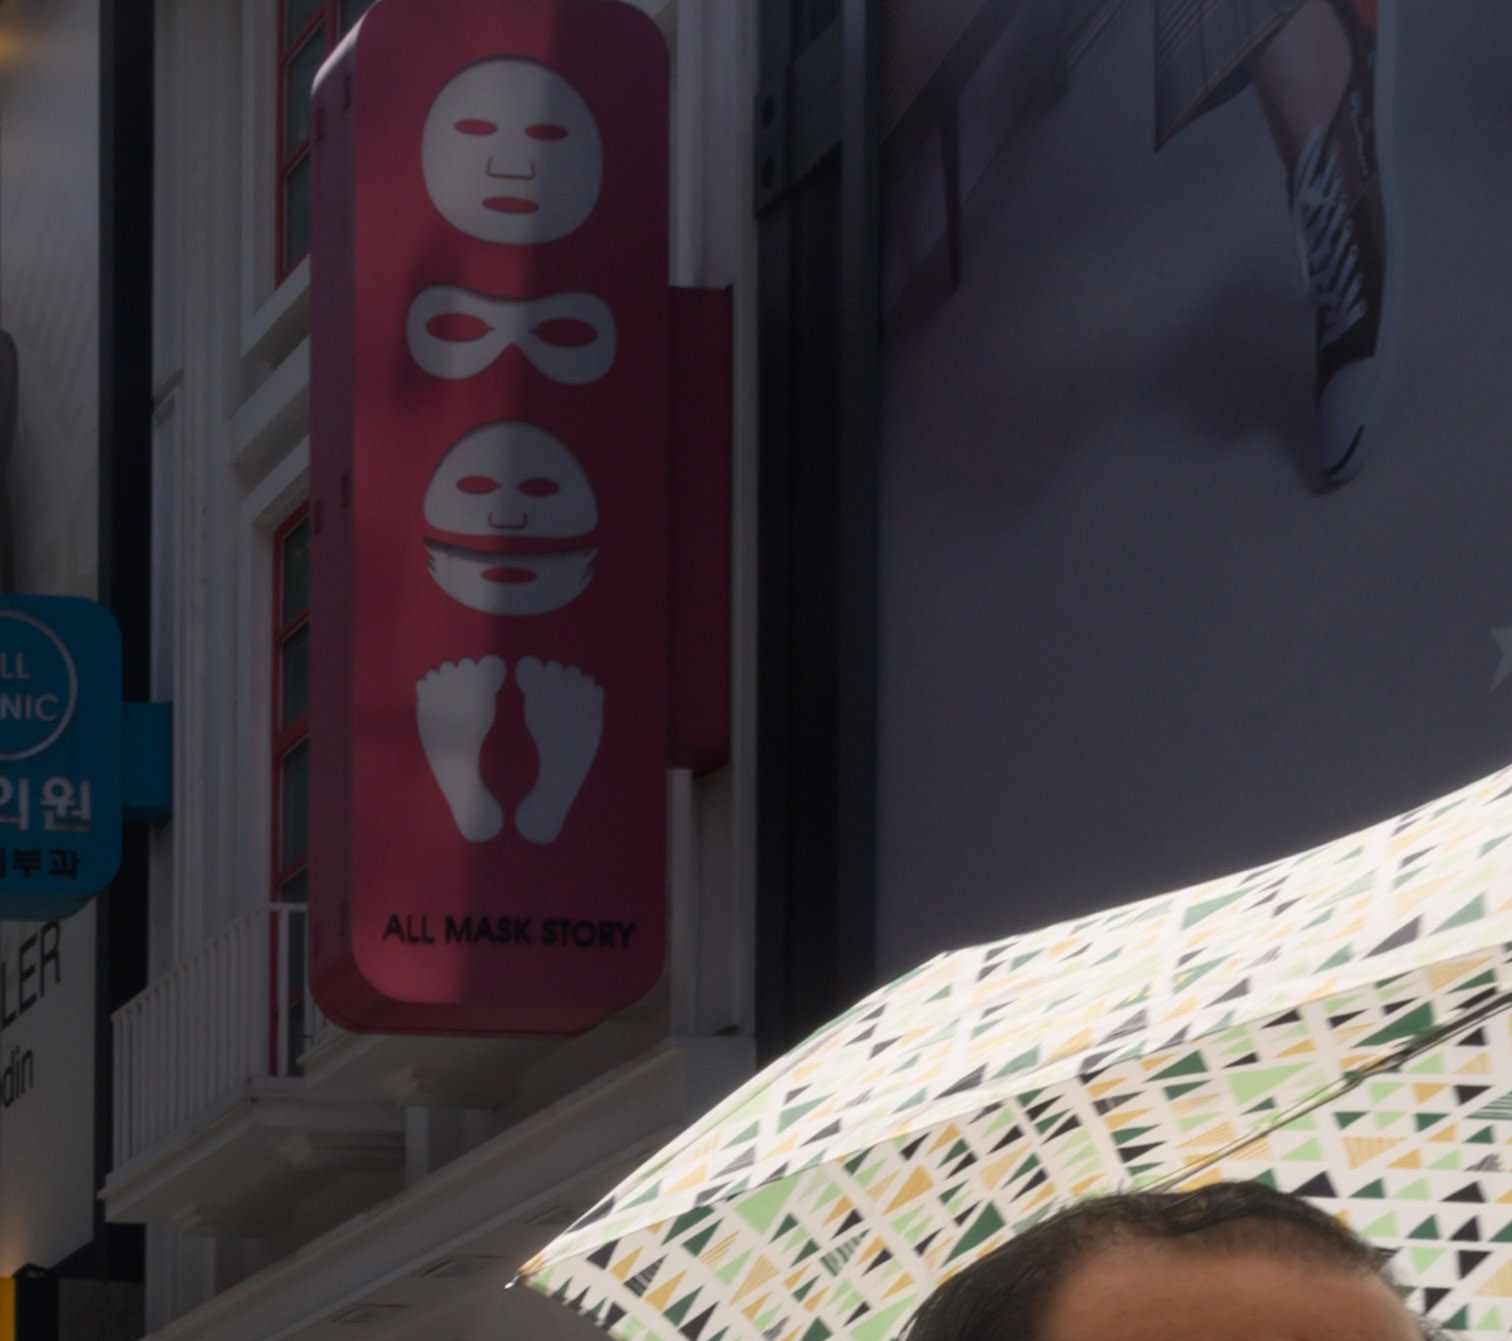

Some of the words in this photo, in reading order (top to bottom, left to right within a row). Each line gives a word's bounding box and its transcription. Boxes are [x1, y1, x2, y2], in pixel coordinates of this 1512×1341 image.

[382, 912, 436, 944] ALL
[444, 914, 533, 946] MASK
[542, 917, 639, 950] STORY
